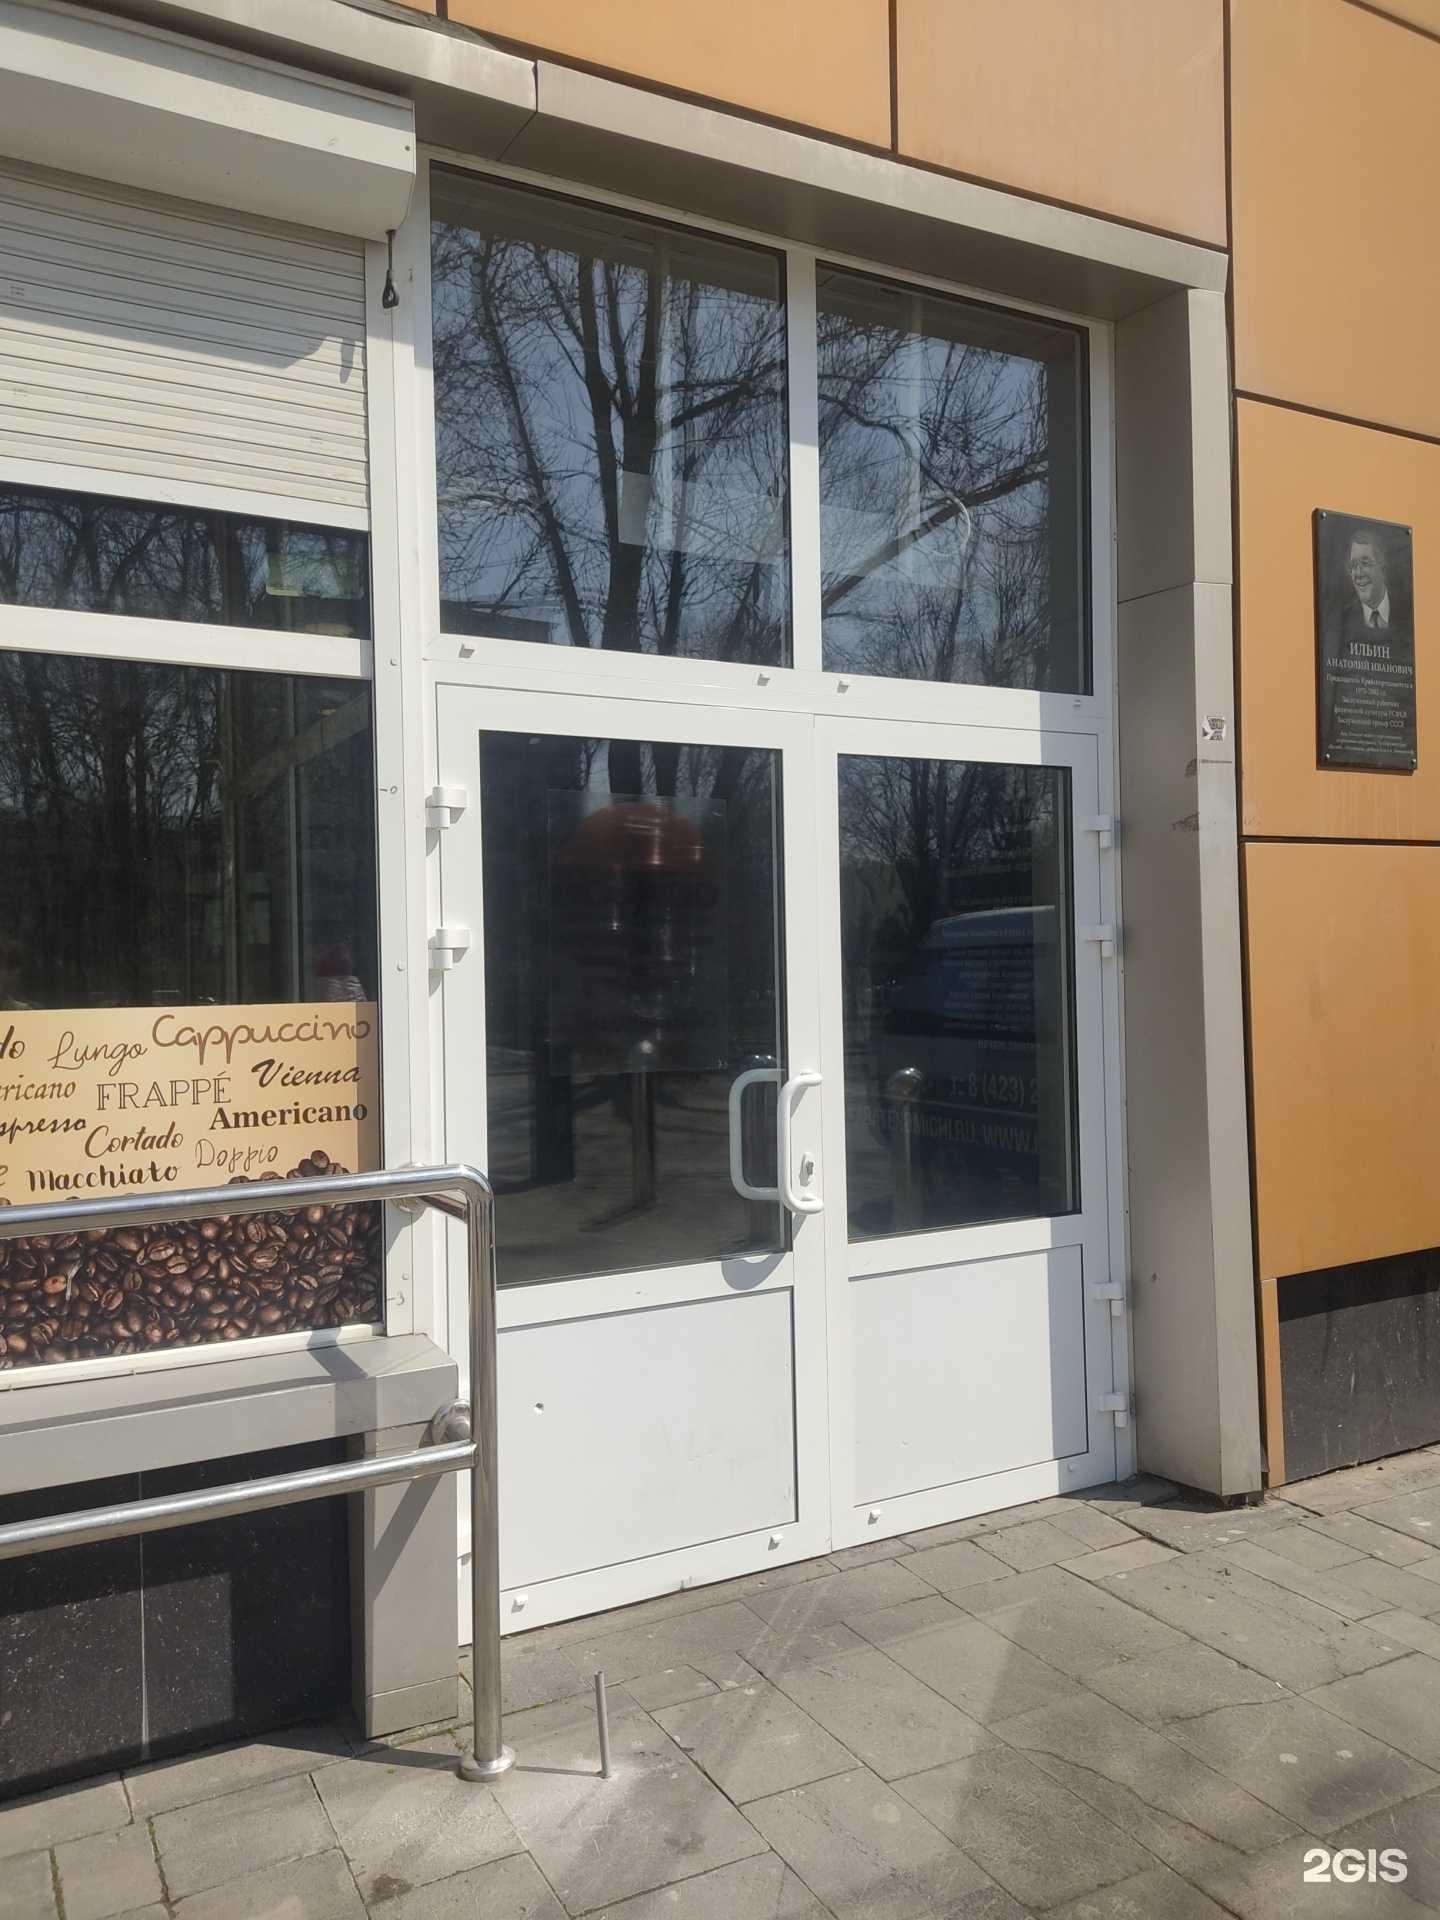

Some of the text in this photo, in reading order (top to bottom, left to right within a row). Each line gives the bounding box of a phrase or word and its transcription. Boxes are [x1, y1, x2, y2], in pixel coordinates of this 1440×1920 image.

[1350, 642, 1391, 659] ИЛЬИН
[47, 1031, 147, 1076] Lungo
[152, 1014, 371, 1065] Cappuccino
[0, 1074, 76, 1101] ricano
[251, 1058, 363, 1088] Vienna
[97, 1070, 232, 1110] FRAPPÉ
[209, 1102, 368, 1130] Americano
[85, 1121, 183, 1159] Cortado
[195, 1138, 279, 1173] Doppio
[25, 1160, 182, 1192] Macchiato
